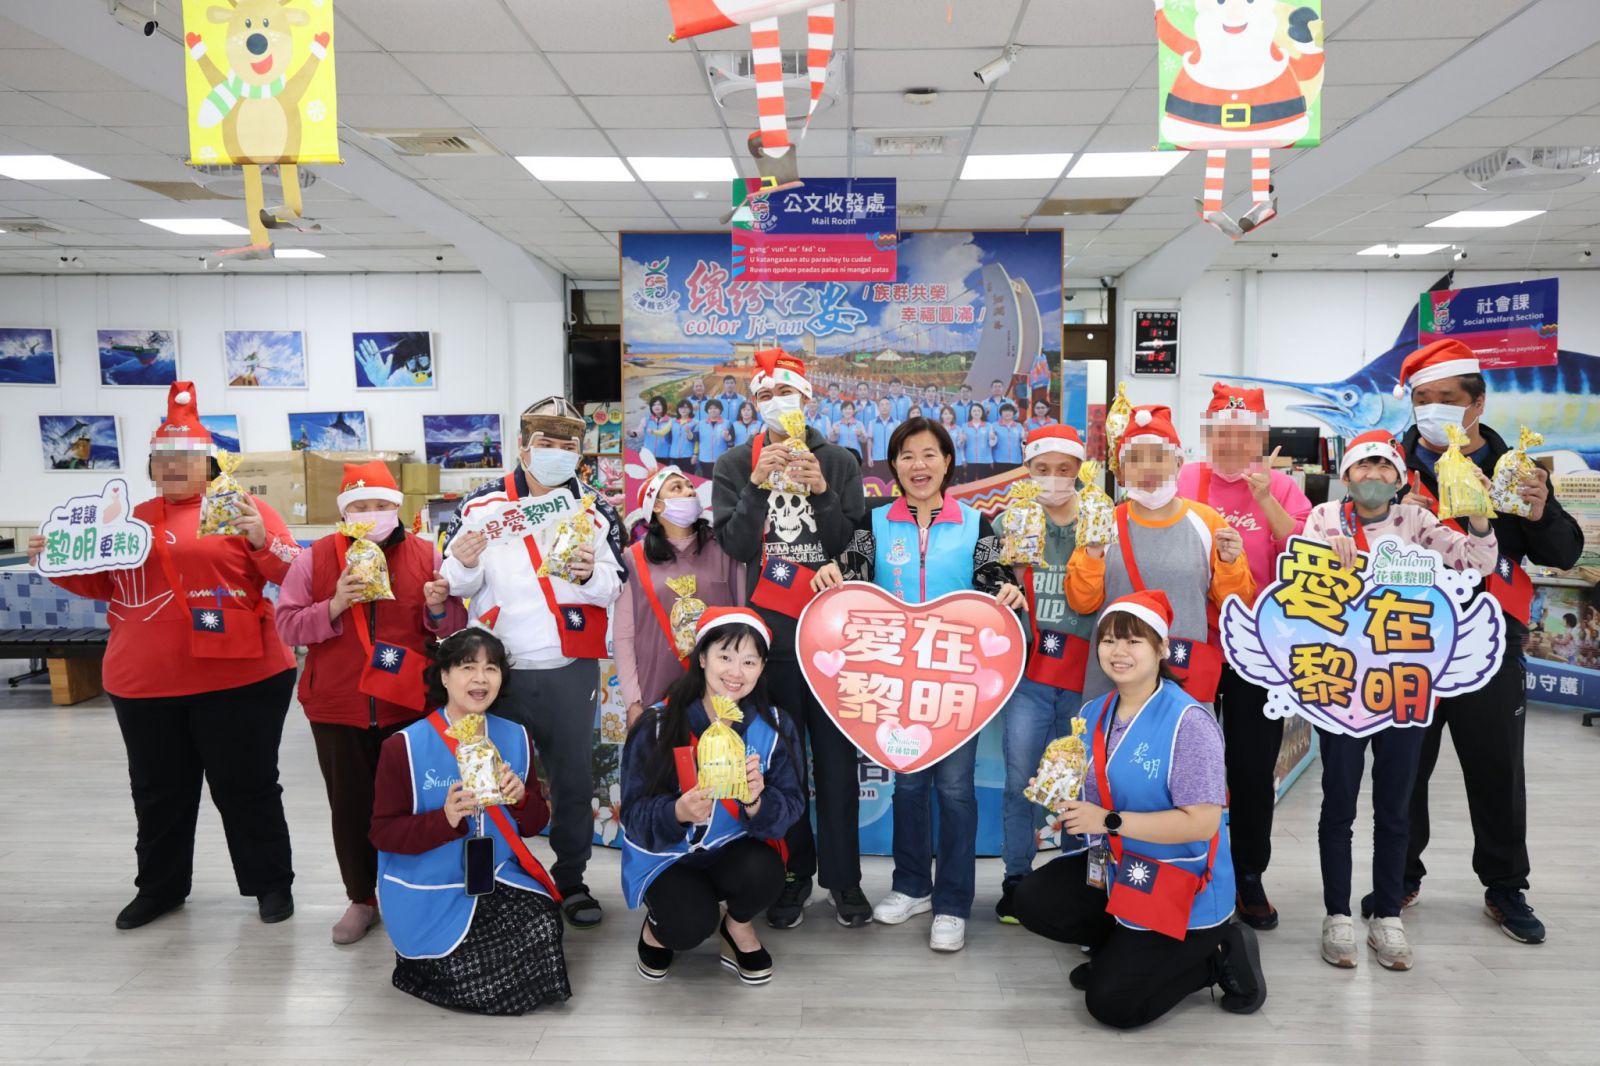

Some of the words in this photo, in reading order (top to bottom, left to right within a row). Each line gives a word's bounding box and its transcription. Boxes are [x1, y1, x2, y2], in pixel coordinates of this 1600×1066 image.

[783, 192, 886, 214] 公文收發處
[811, 217, 830, 225] Mail
[832, 217, 857, 225] Room
[873, 284, 947, 302] 族群共榮
[901, 306, 975, 324] 幸福圓滿
[1476, 294, 1530, 315] 社會課
[685, 315, 740, 335] color
[745, 315, 804, 338] Ji-an
[1463, 318, 1485, 326] Social
[1486, 314, 1514, 324] Welfare
[1515, 312, 1544, 321] Section
[57, 504, 98, 526] 一起讓
[1375, 542, 1433, 569] Shalom
[1375, 570, 1433, 585] 花蓮黎明
[841, 609, 977, 674] 愛在
[1289, 642, 1433, 724] 黎明
[837, 670, 978, 732] 黎明
